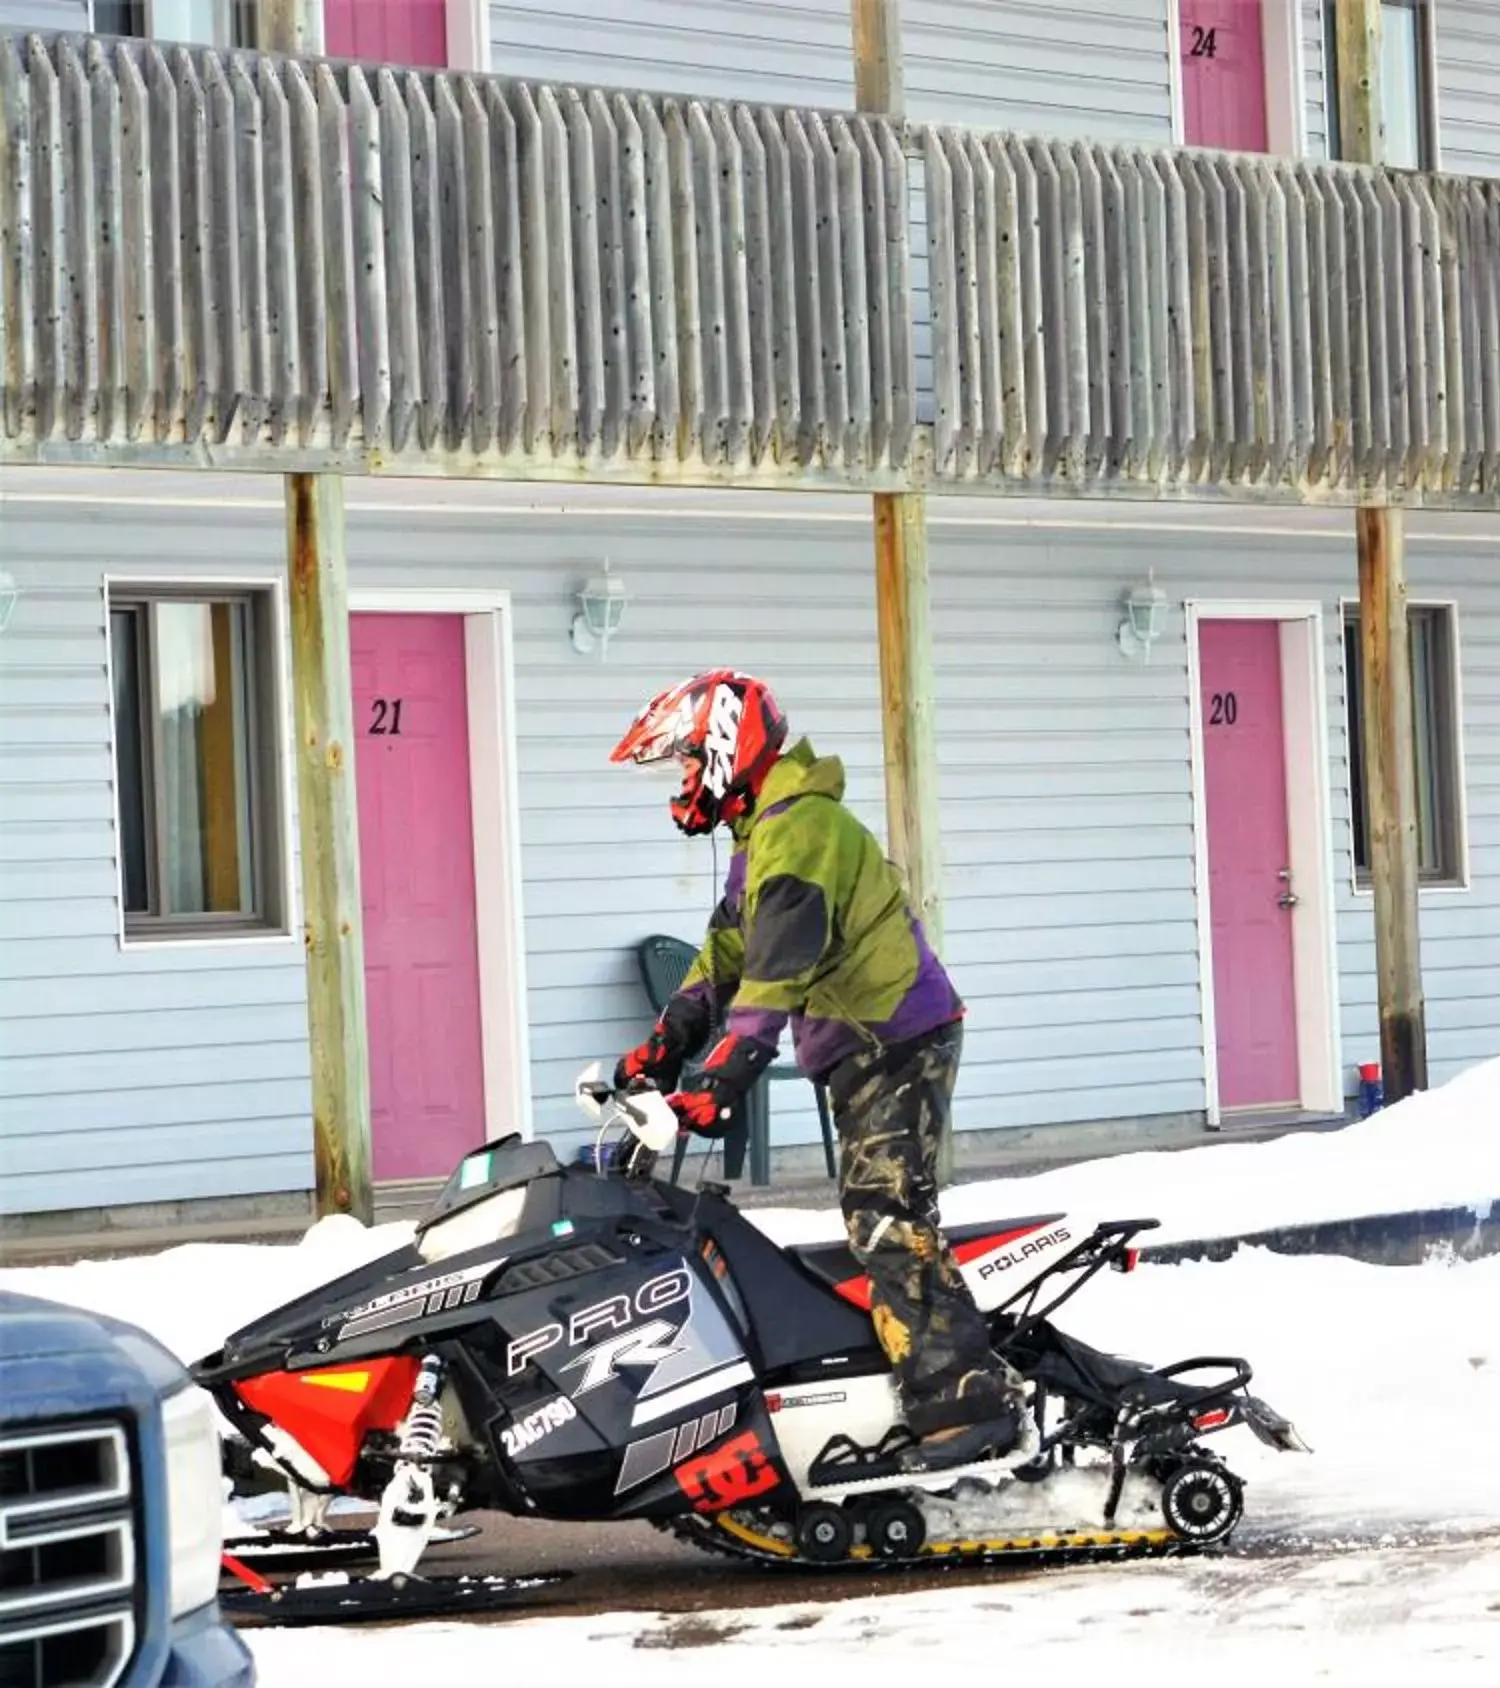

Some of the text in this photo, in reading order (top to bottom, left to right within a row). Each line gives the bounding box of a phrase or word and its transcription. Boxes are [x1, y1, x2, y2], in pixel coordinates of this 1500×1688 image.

[1191, 26, 1216, 58] 24
[368, 699, 402, 735] 21
[1209, 691, 1237, 725] 20
[978, 1227, 1071, 1281] POLARIS
[507, 1268, 693, 1377] PRO
[558, 1318, 691, 1399] R
[501, 1396, 578, 1458] 2AC790
